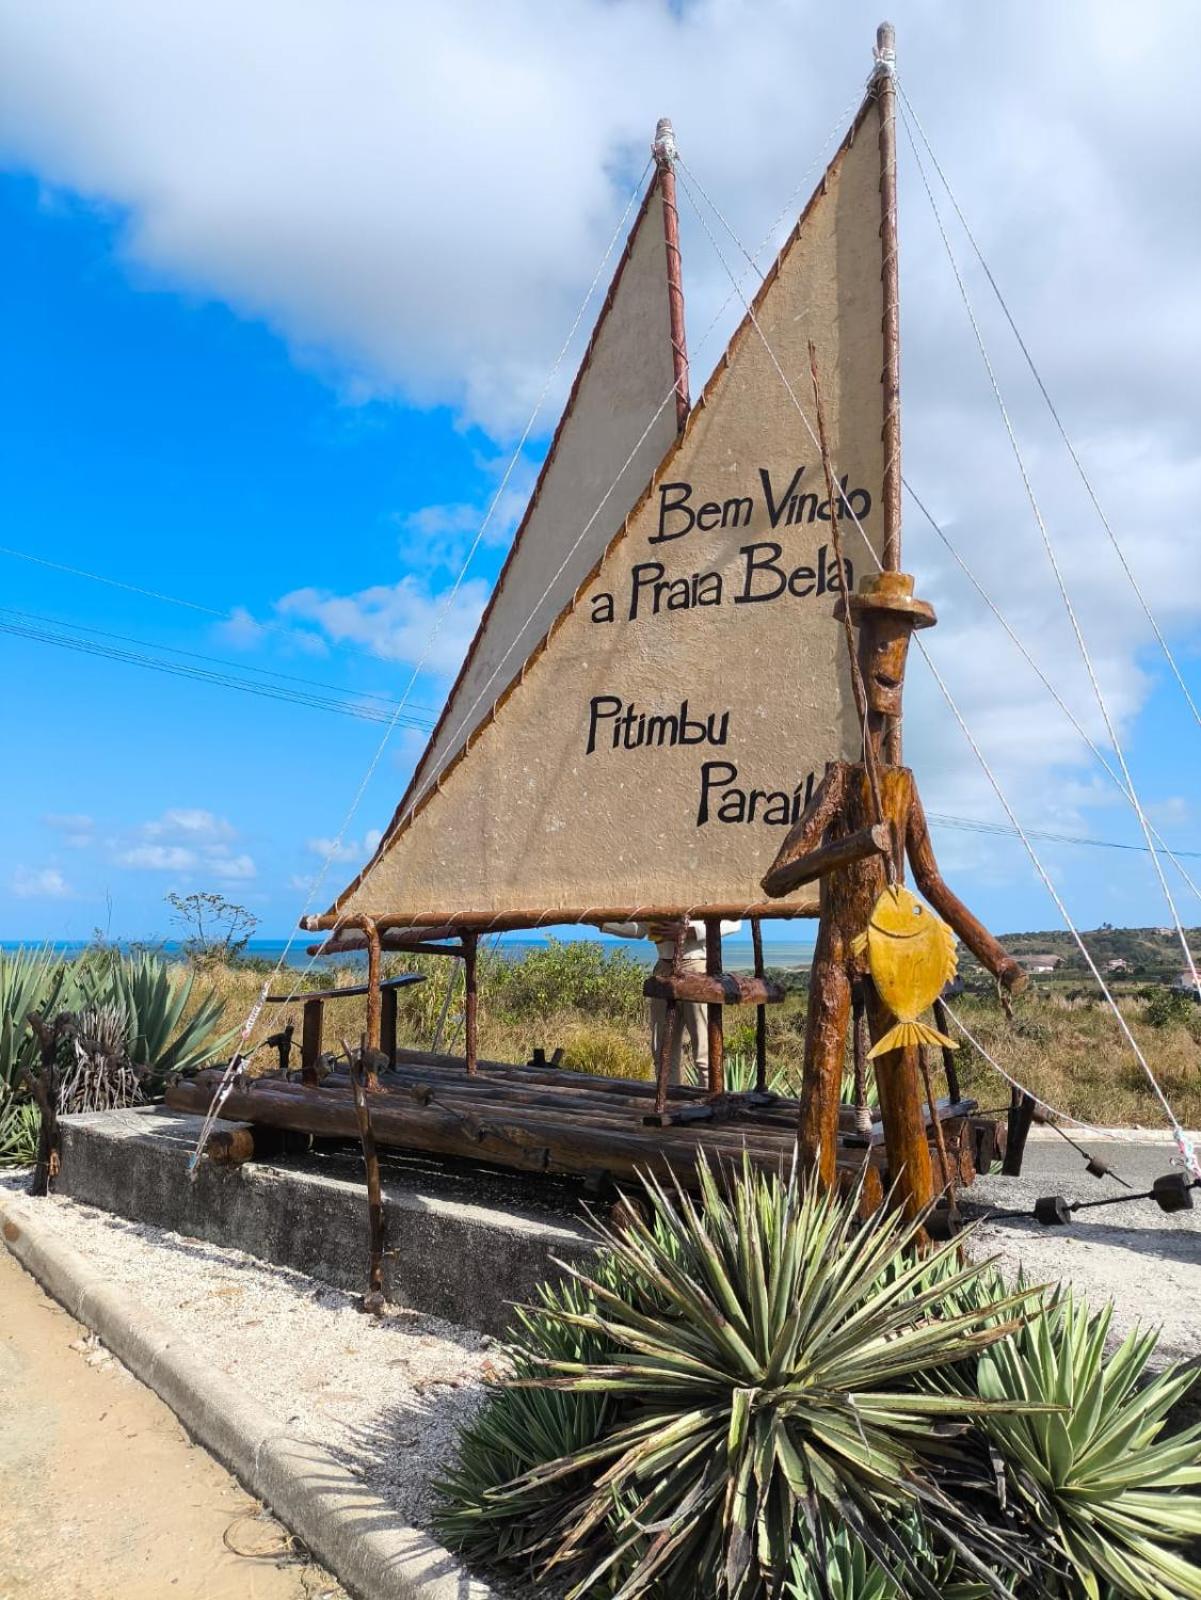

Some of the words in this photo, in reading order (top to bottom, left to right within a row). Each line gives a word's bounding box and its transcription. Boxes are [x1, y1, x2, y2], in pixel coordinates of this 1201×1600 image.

[648, 482, 753, 545] Bem
[759, 466, 872, 529] Vindo
[591, 592, 614, 624] a
[628, 562, 723, 621] Praia
[734, 542, 854, 604] Bela
[586, 696, 730, 755] Pitimbu
